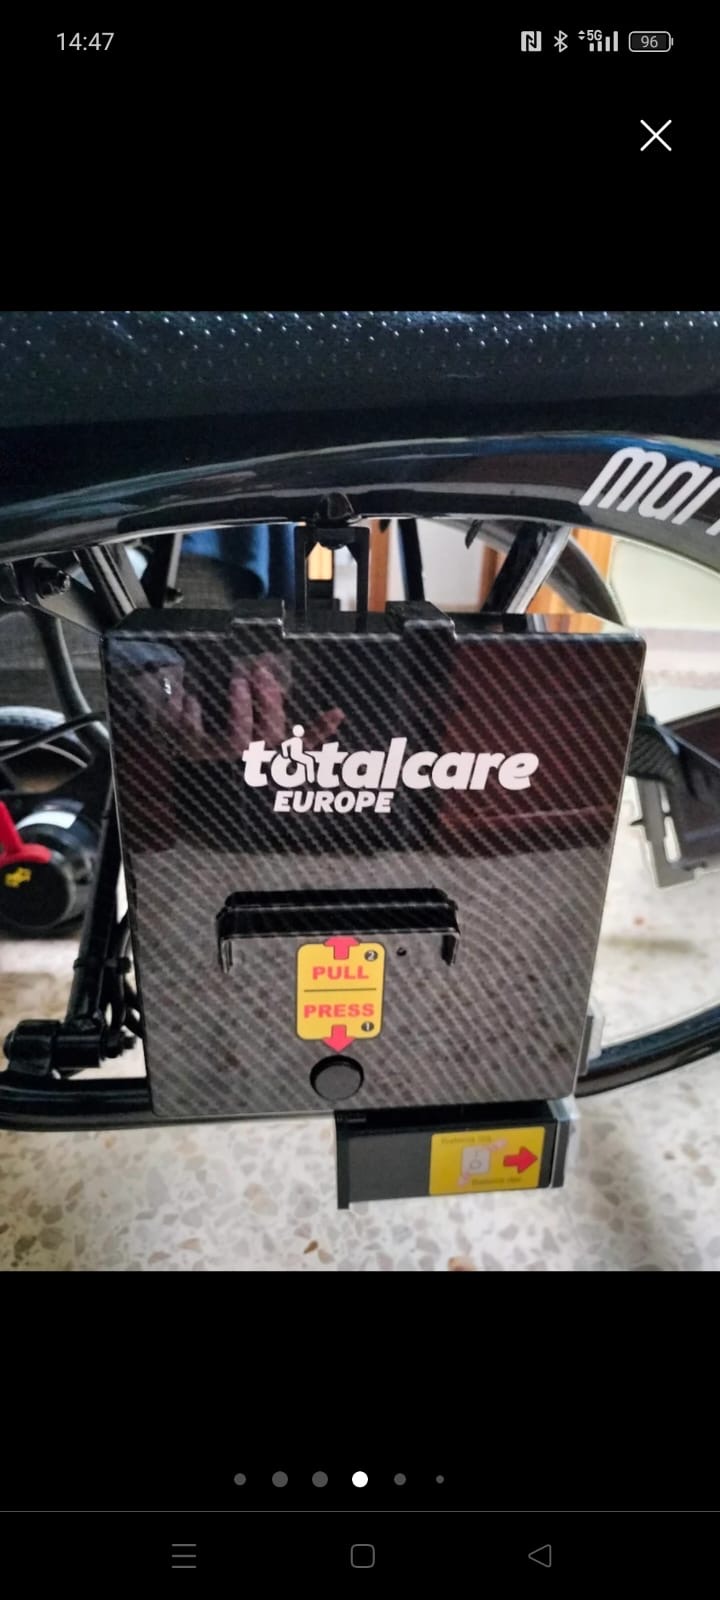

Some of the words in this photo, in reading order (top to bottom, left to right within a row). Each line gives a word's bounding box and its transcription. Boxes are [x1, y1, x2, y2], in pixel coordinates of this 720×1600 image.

[578, 446, 720, 536] mar
[242, 736, 540, 791] totalcare
[273, 790, 395, 813] EUROPE
[312, 965, 369, 981] PULL
[303, 1003, 375, 1019] PRESS
